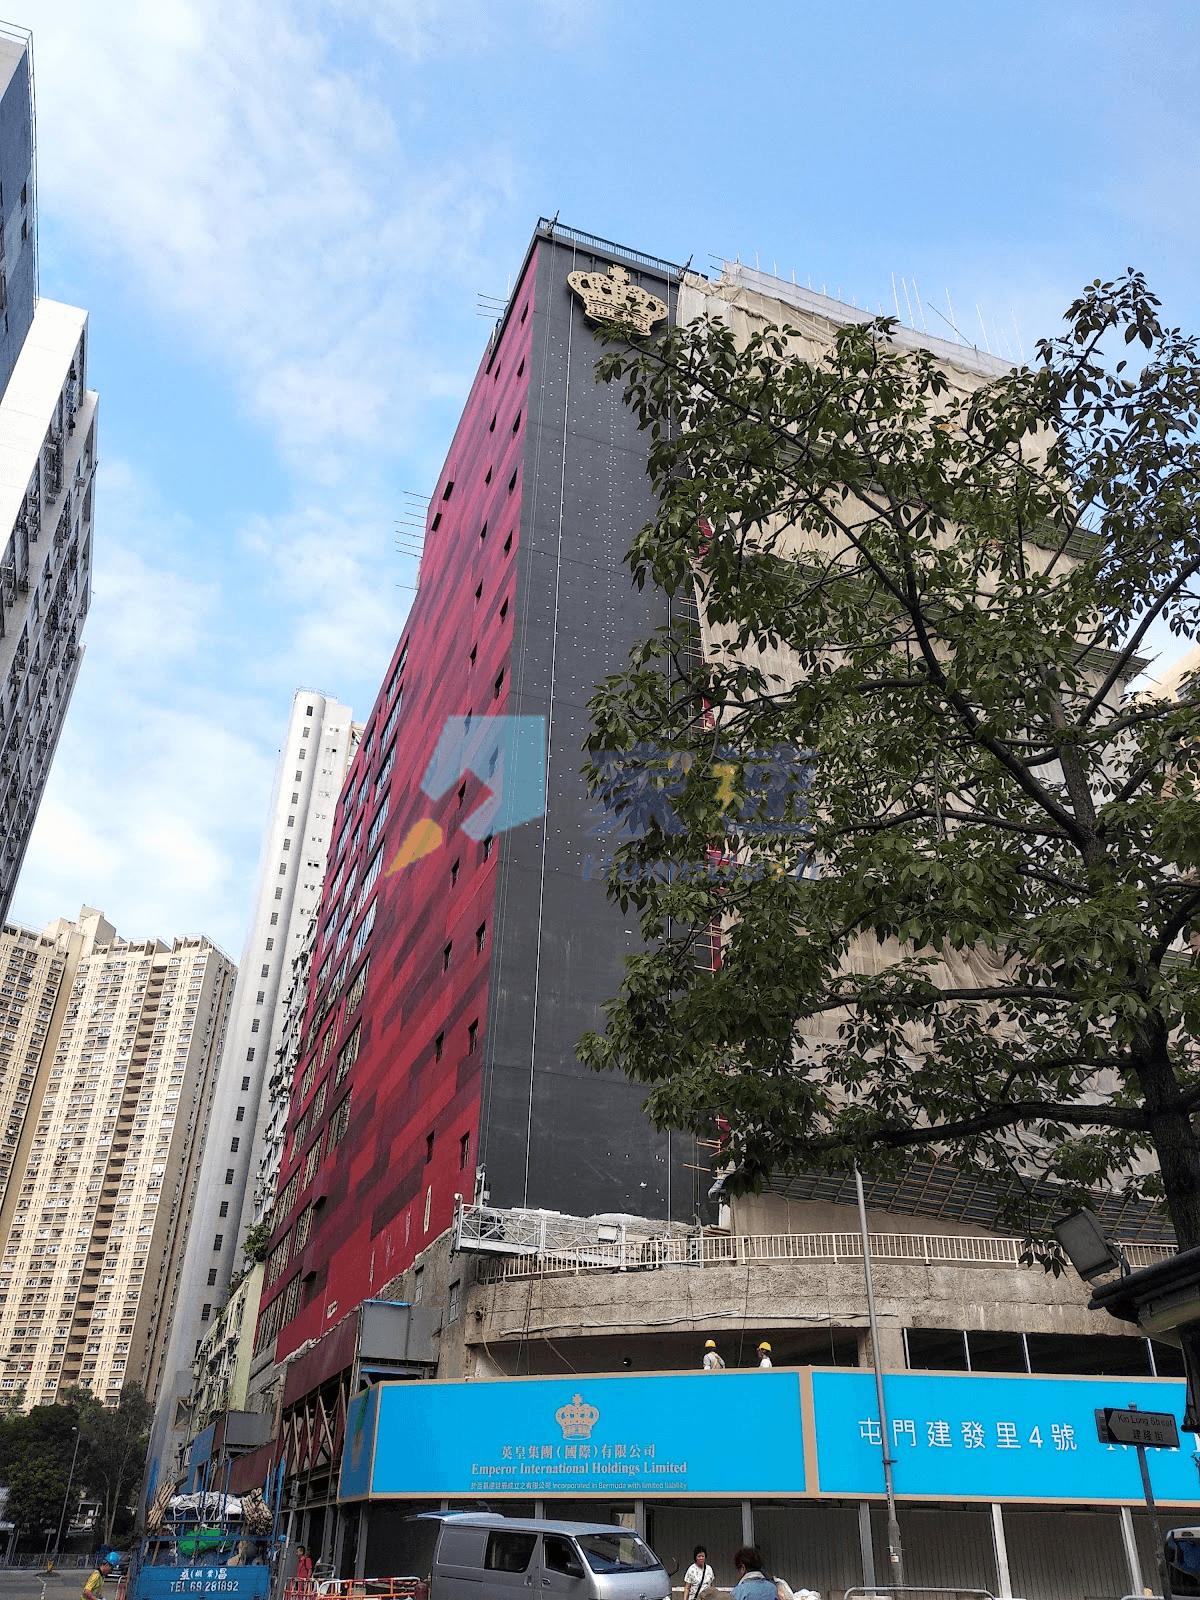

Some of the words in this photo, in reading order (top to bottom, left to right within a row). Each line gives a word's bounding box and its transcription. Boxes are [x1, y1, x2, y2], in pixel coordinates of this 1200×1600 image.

[1117, 1414, 1130, 1424] Kin
[1131, 1415, 1149, 1426] Lung
[1150, 1416, 1173, 1428] Street
[858, 1417, 1077, 1451] 屯門建發里4號
[471, 1463, 517, 1478] Emperor
[520, 1462, 589, 1474] International
[592, 1462, 640, 1477] Holdings
[643, 1461, 687, 1474] Limited
[553, 1482, 590, 1490] Incorporated
[665, 1482, 687, 1491] liability
